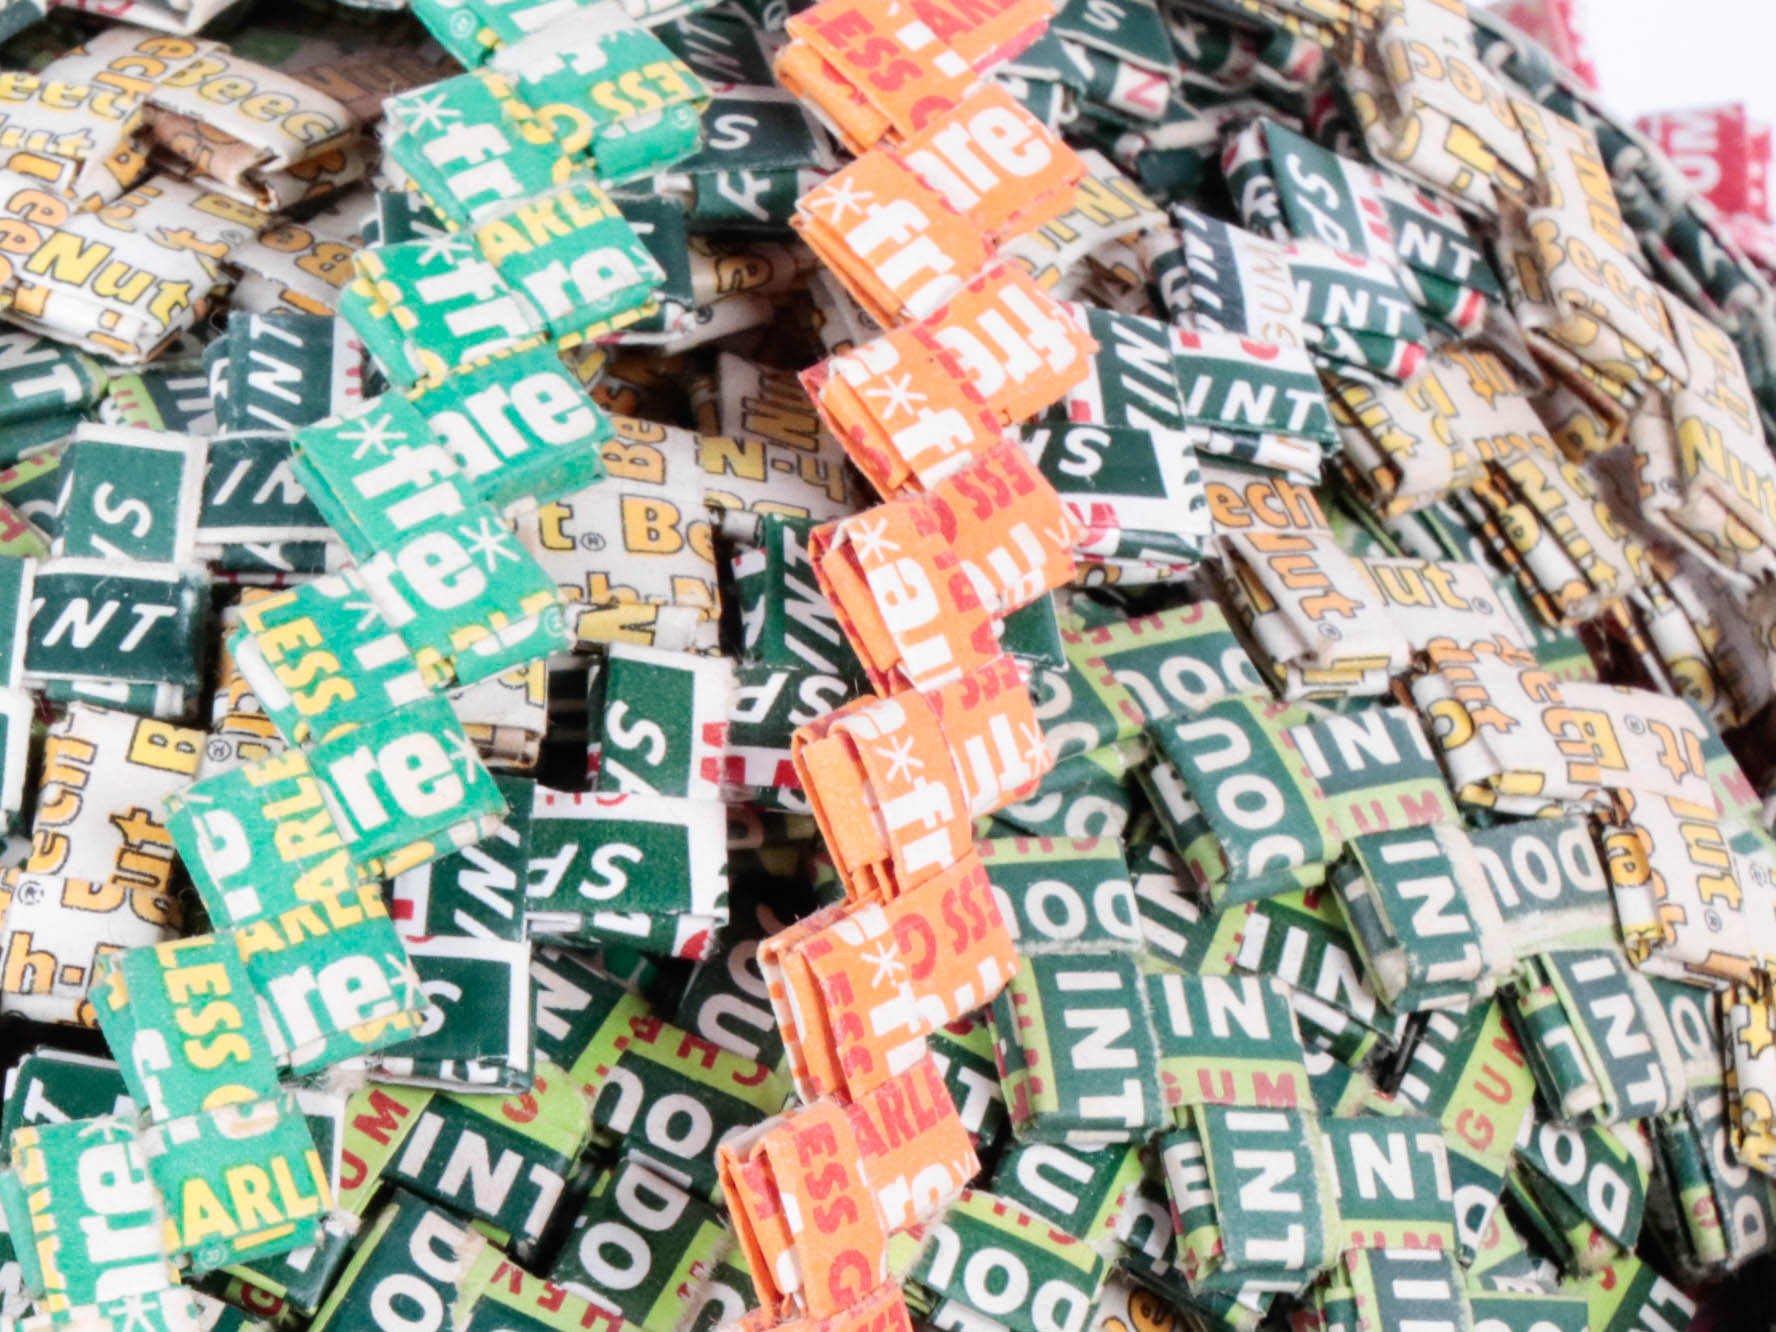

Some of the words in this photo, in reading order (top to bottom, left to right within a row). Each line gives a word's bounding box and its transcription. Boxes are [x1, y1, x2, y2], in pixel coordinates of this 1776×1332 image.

[26, 230, 191, 326] Nut
[1186, 375, 1323, 434] INT
[357, 530, 490, 630] re
[237, 590, 359, 720] LESS
[327, 731, 466, 843] re
[1176, 716, 1307, 882] DOU
[1381, 840, 1483, 984] INT
[156, 939, 253, 1070] LESS
[266, 954, 396, 1061] re
[1054, 970, 1145, 1129] INT
[1572, 956, 1668, 1111] INT
[397, 1112, 566, 1243] INT
[794, 1120, 860, 1235] ESS
[1225, 1111, 1305, 1272] INT
